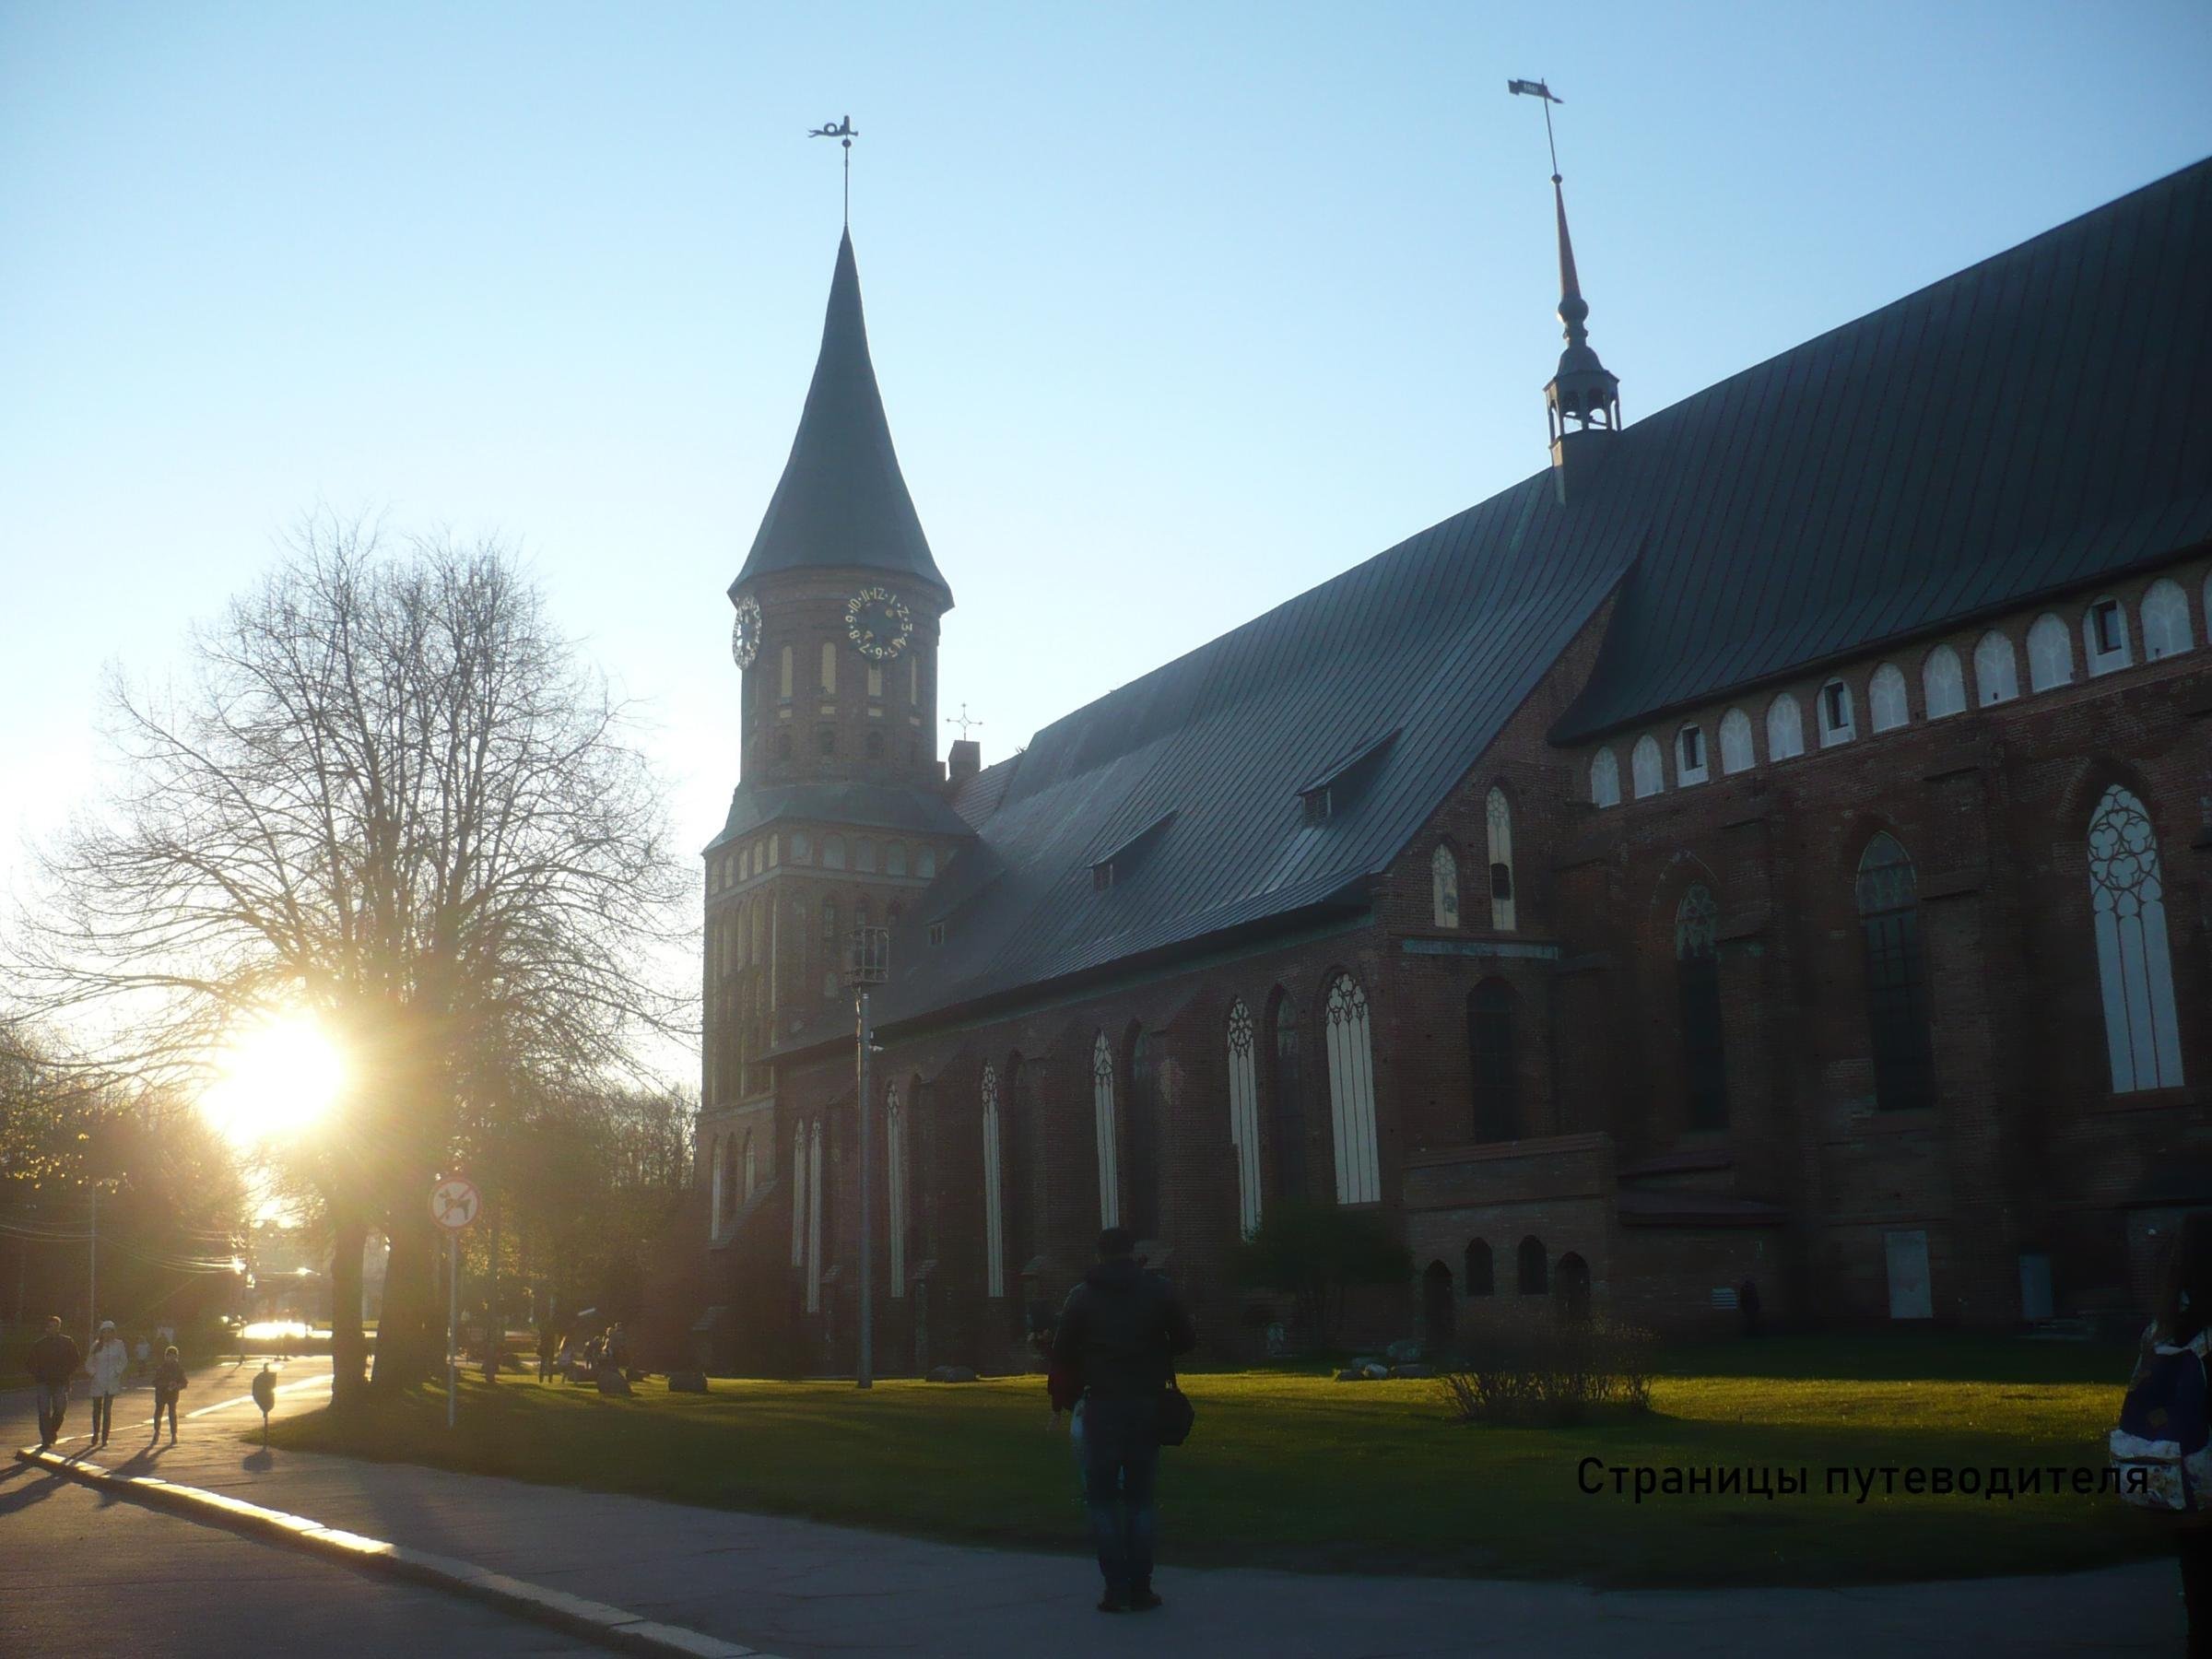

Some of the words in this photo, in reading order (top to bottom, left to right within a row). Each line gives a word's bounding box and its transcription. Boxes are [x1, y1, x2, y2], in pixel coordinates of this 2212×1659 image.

[860, 589, 870, 602] 11
[873, 587, 885, 600] 12
[848, 598, 862, 612] 10
[890, 594, 897, 605] 1
[897, 606, 910, 618] 2
[844, 615, 856, 623] 9
[901, 623, 913, 631] 3
[849, 629, 860, 639] 8
[858, 643, 869, 653] 7
